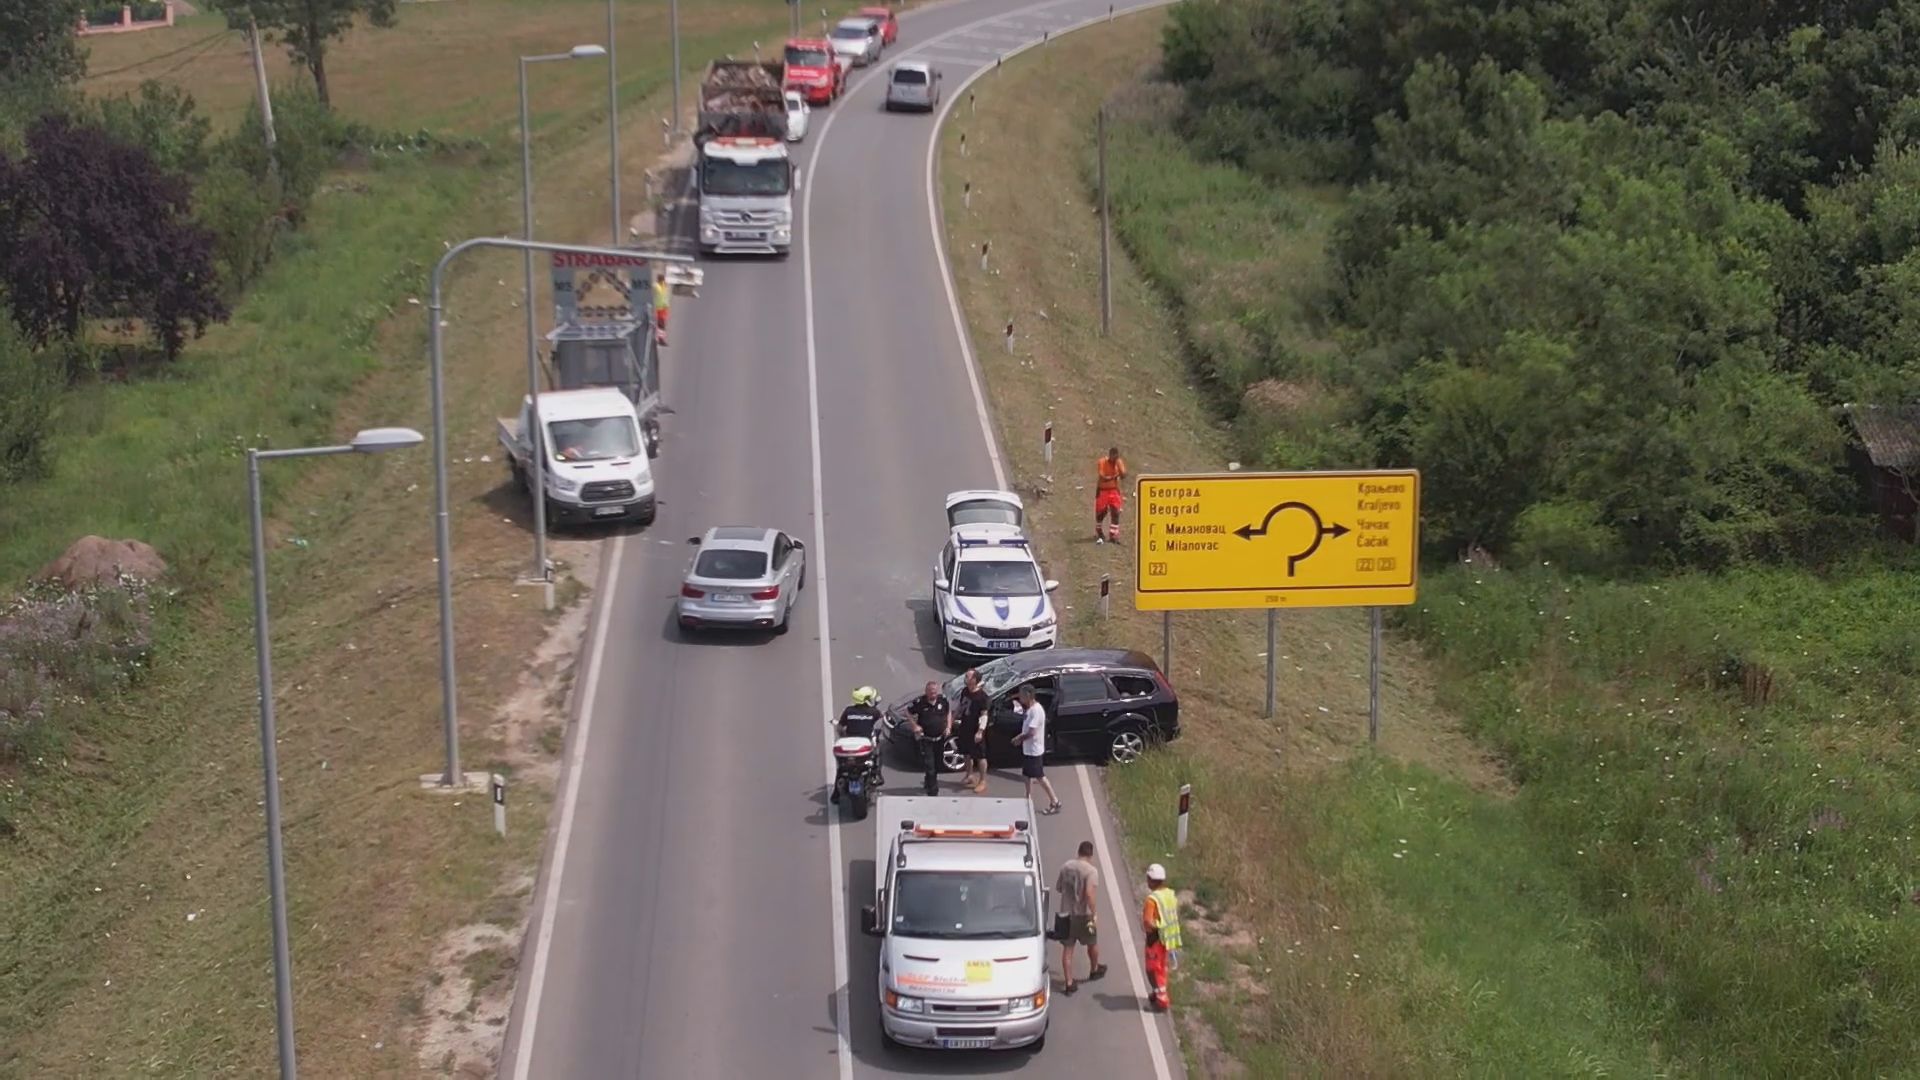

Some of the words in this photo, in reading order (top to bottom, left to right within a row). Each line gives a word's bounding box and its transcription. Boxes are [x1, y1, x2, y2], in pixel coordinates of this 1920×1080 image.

[1149, 486, 1201, 499] Београд
[1149, 502, 1200, 517] Beograd
[1357, 499, 1401, 513] Kraljevo
[1166, 523, 1226, 535] Милановац
[1357, 519, 1390, 530] Чачак
[1166, 540, 1219, 552] Milanovac
[1152, 565, 1164, 575] 22
